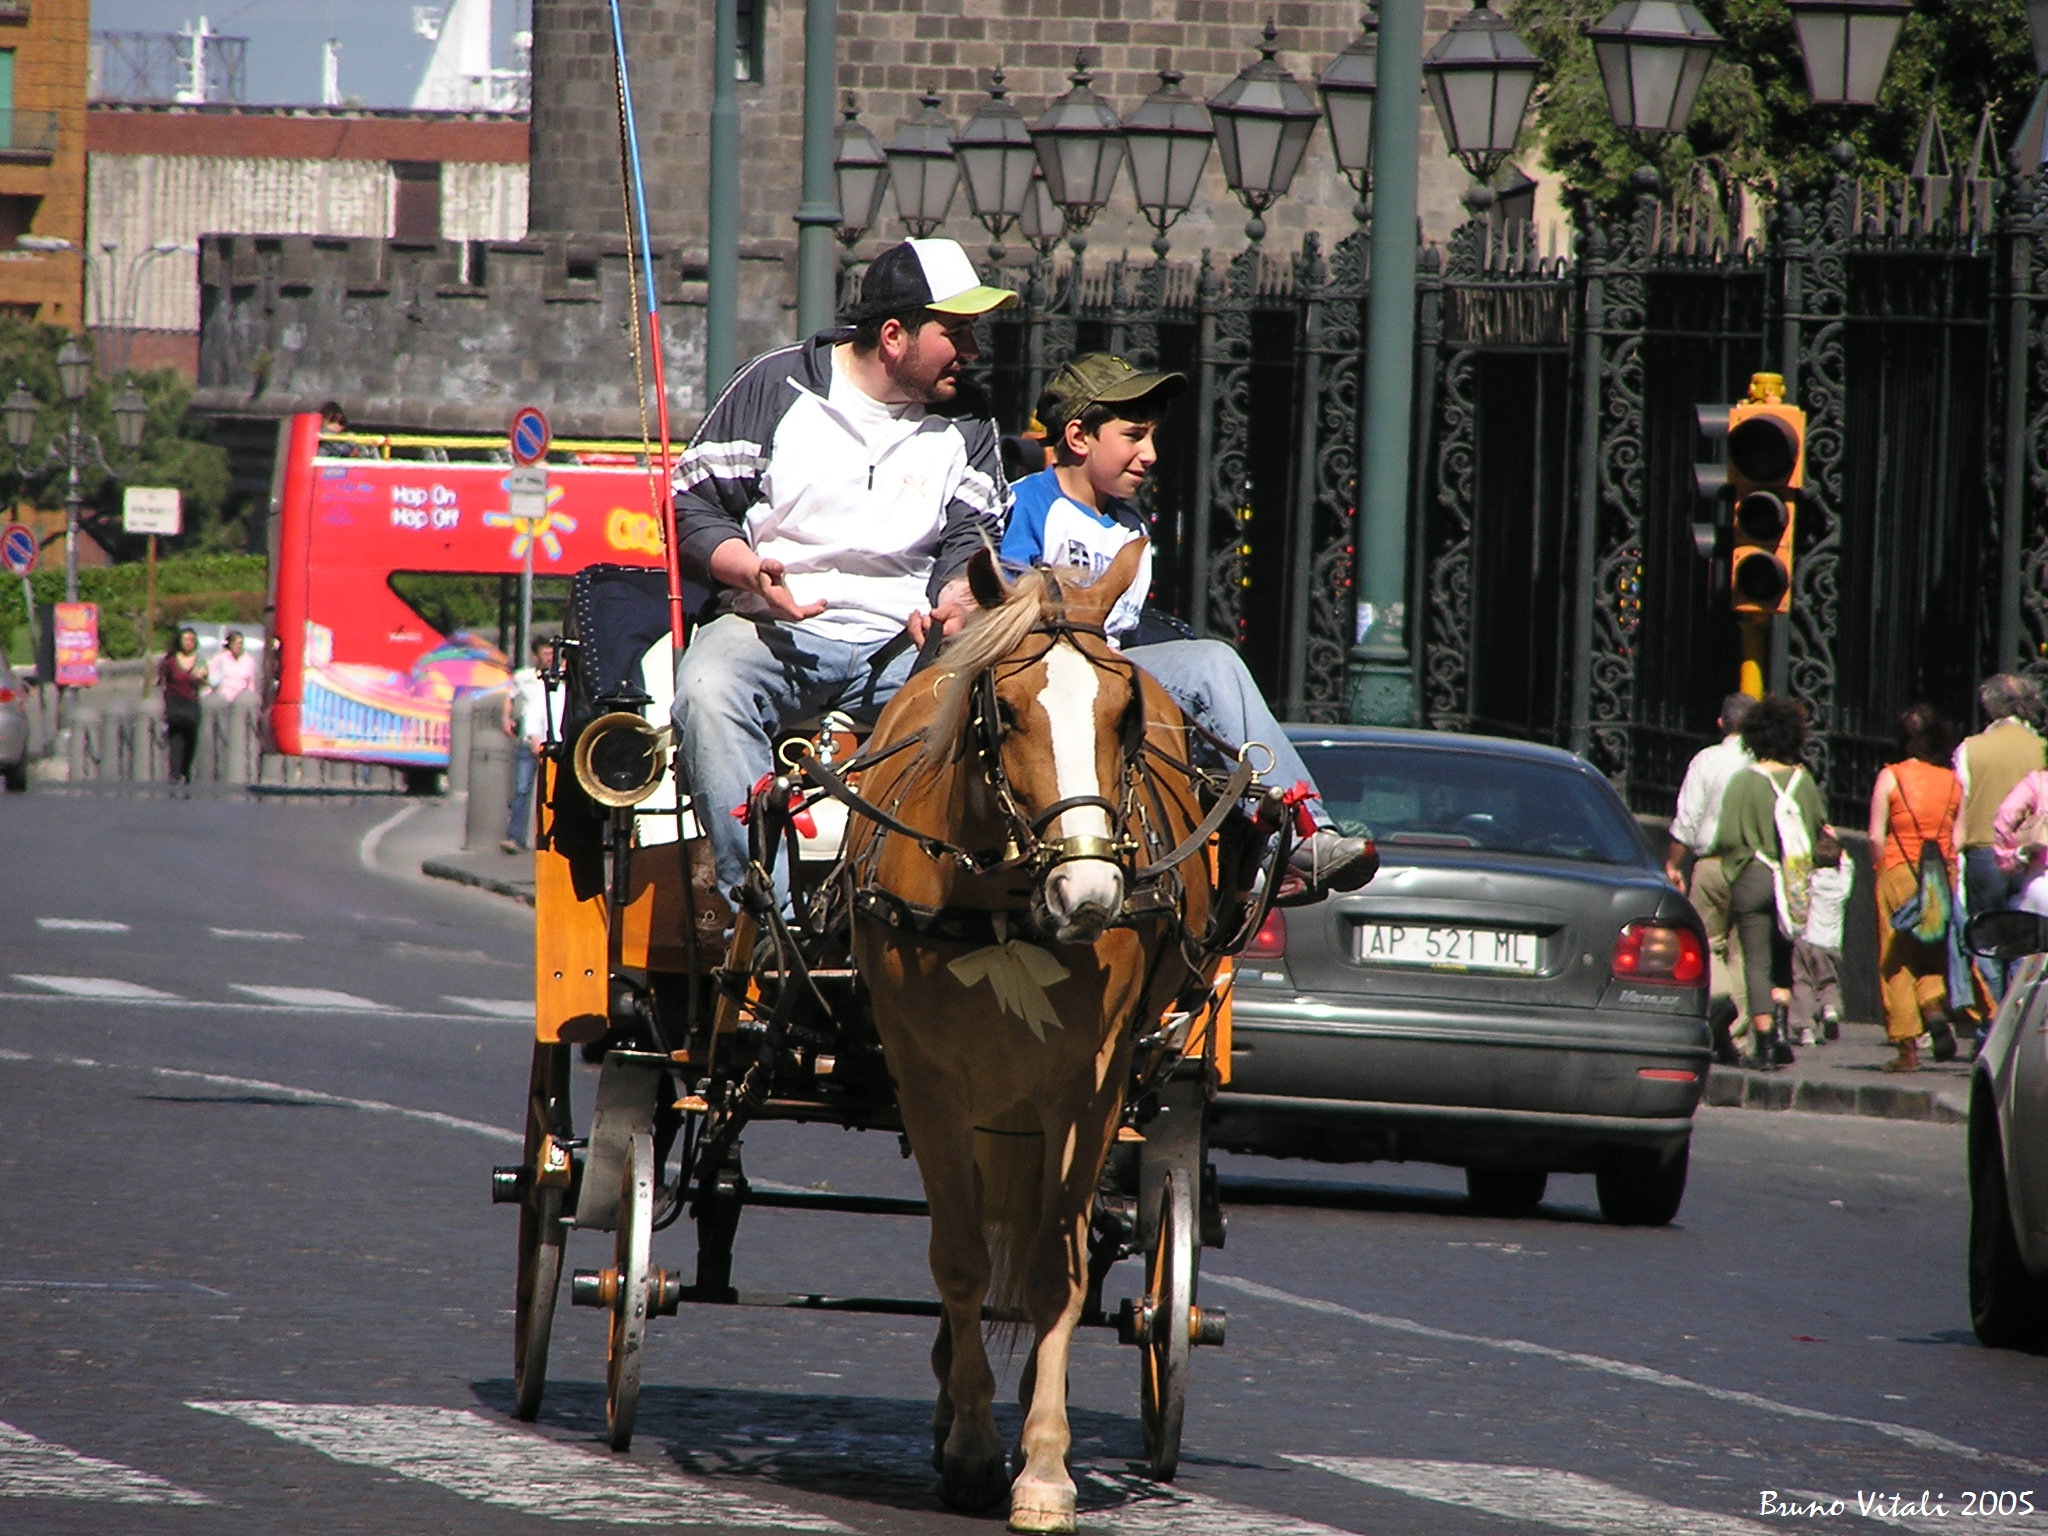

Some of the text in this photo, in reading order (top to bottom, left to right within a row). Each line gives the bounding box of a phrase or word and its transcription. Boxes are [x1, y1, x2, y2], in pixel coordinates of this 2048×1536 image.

[391, 486, 428, 507] Hop
[431, 484, 457, 505] On
[391, 507, 460, 529] Hop Off
[1370, 925, 1528, 964] AP 521 ML
